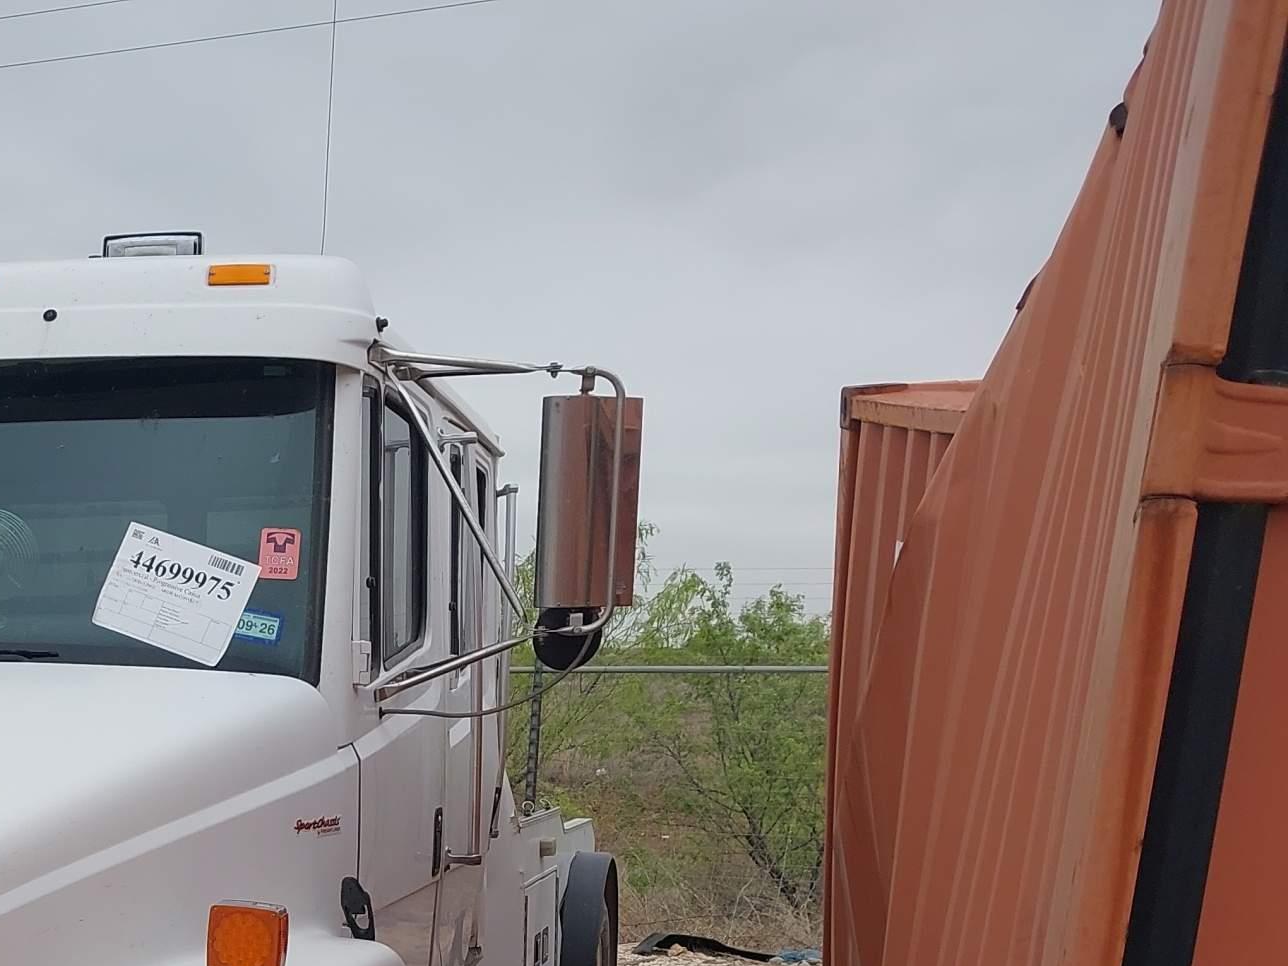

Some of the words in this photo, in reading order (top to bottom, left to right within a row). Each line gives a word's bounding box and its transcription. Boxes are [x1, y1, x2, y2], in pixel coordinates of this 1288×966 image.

[130, 550, 236, 601] 44699975
[268, 566, 289, 575] 2022
[258, 622, 276, 636] 26
